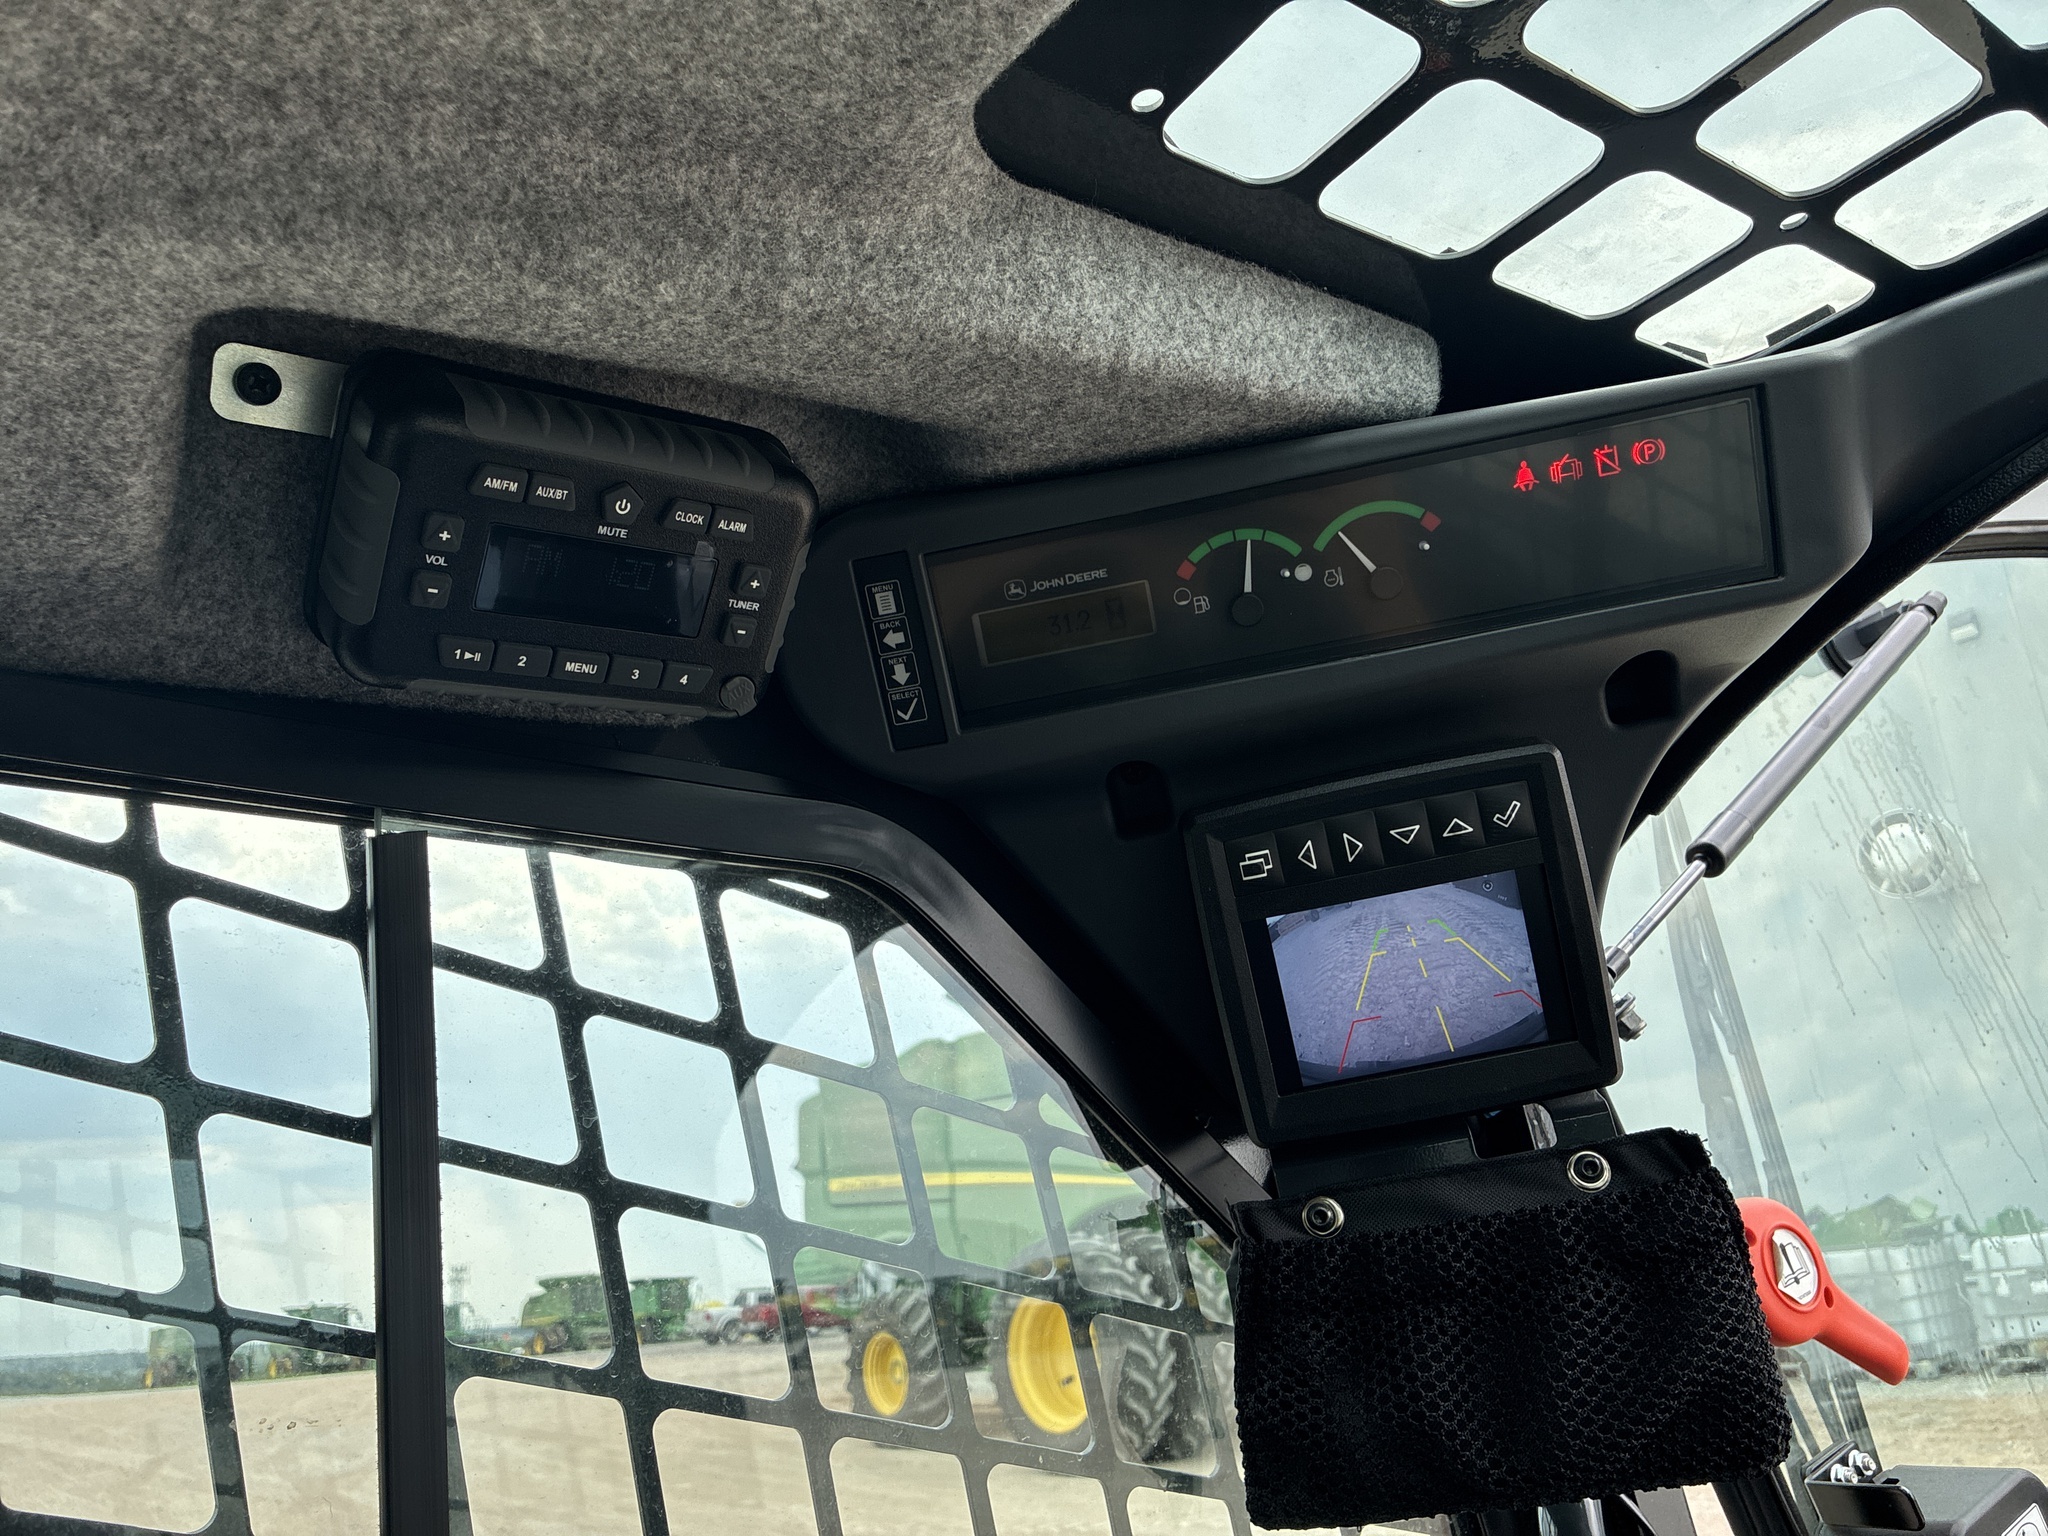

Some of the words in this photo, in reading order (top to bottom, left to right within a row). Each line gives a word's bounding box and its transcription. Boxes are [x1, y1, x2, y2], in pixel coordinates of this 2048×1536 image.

[483, 477, 518, 492] AM/FM
[535, 486, 569, 500] AUX/BT
[675, 511, 705, 525] CLOCK
[597, 525, 629, 539] MUTE
[717, 519, 748, 533] ALARM
[425, 554, 448, 566] VOL
[521, 543, 563, 577] AM
[1030, 577, 1065, 593] JOHN
[1065, 568, 1109, 585] DEERE
[871, 583, 894, 594] MENU
[728, 599, 760, 612] TUNER
[880, 620, 901, 631] BACK
[1046, 609, 1091, 635] 31.2
[454, 649, 461, 660] 1
[517, 655, 527, 667] 2
[888, 656, 908, 666] NEXT
[565, 662, 598, 675] MENU
[631, 669, 640, 680] 3
[679, 674, 688, 686] 4
[728, 681, 751, 705] AUX
[891, 690, 920, 701] SELECT
